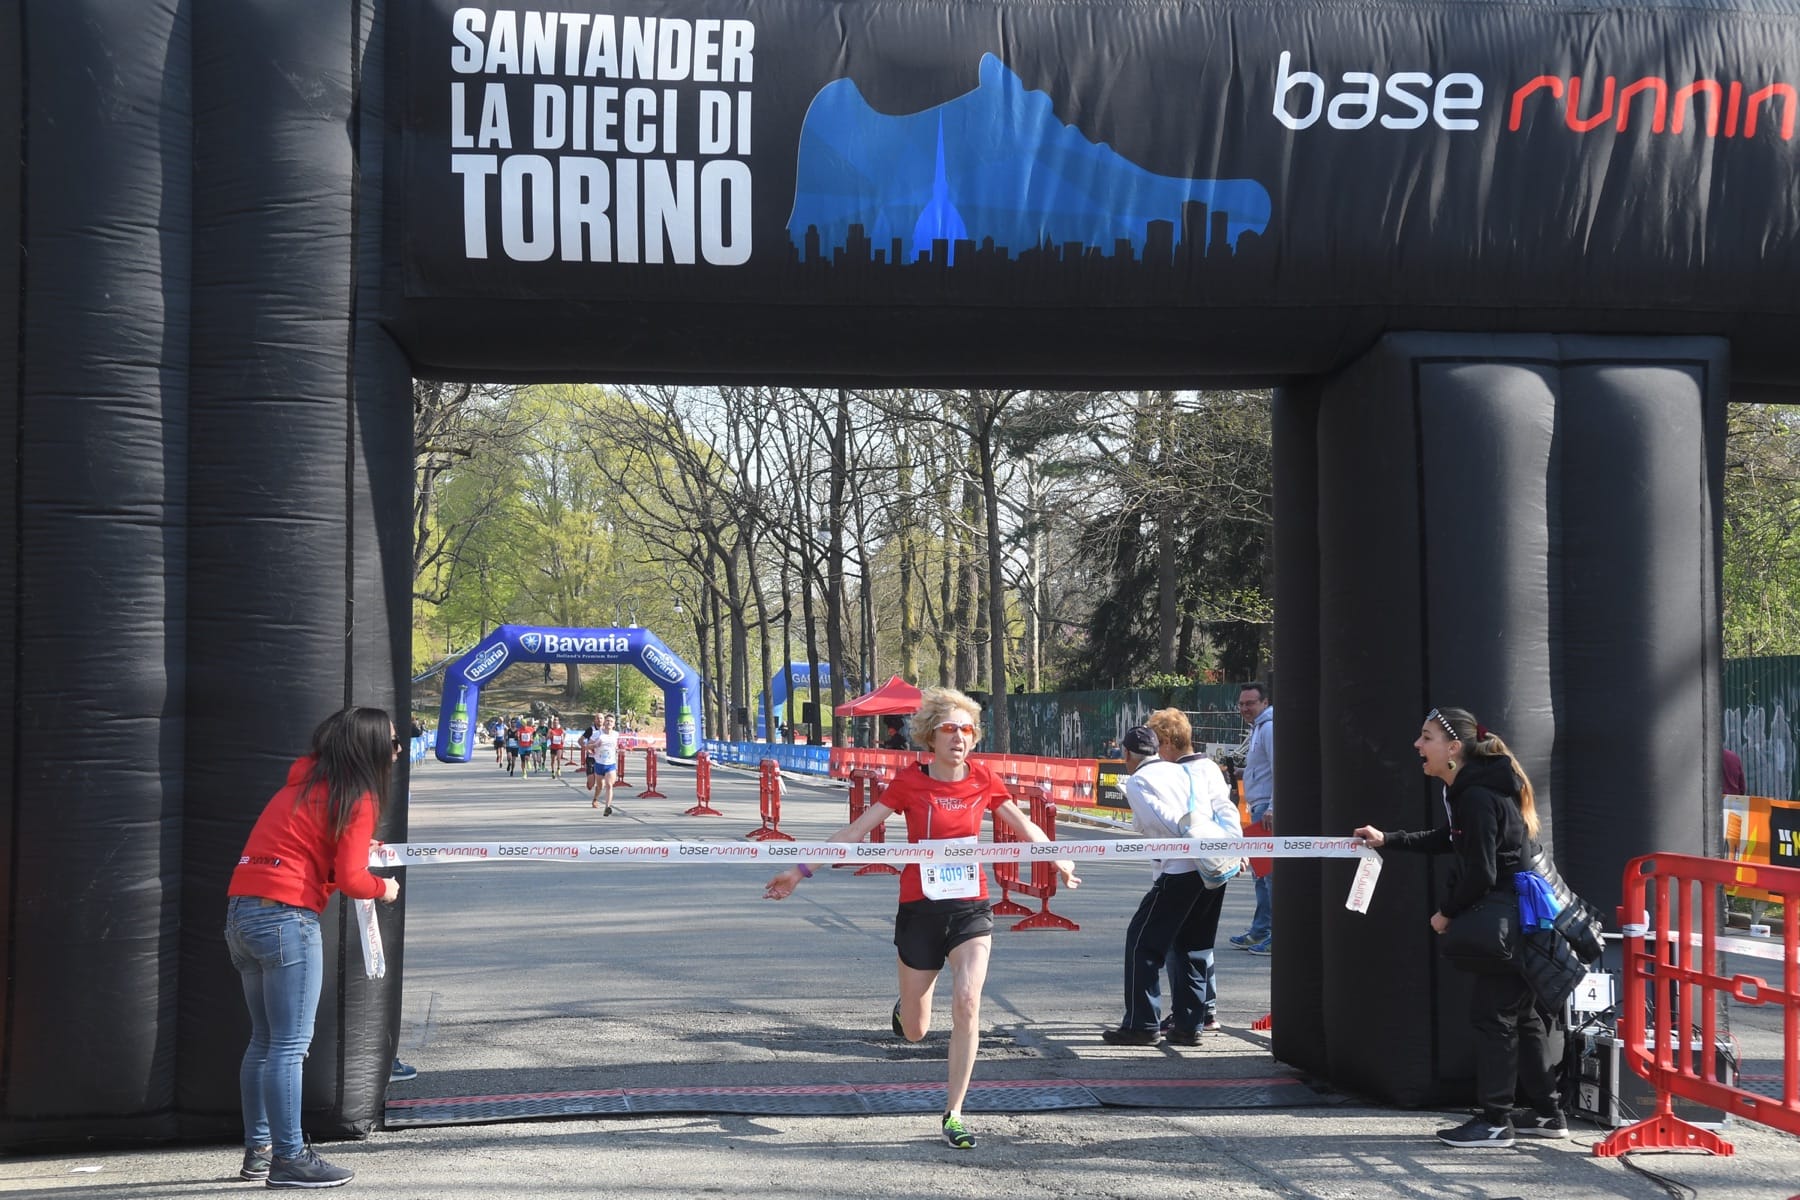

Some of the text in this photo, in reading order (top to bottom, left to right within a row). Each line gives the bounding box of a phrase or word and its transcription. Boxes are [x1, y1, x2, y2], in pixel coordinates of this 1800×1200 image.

[451, 8, 754, 83] SANTANDER
[1272, 50, 1484, 131] base
[451, 82, 752, 155] LA DIECI DI
[451, 154, 753, 266] TORINO
[544, 634, 629, 653] Bavaria
[470, 648, 504, 678] Bavaria
[646, 649, 679, 680] Bavaria
[940, 867, 962, 882] 4019
[1588, 988, 1597, 1000] 4
